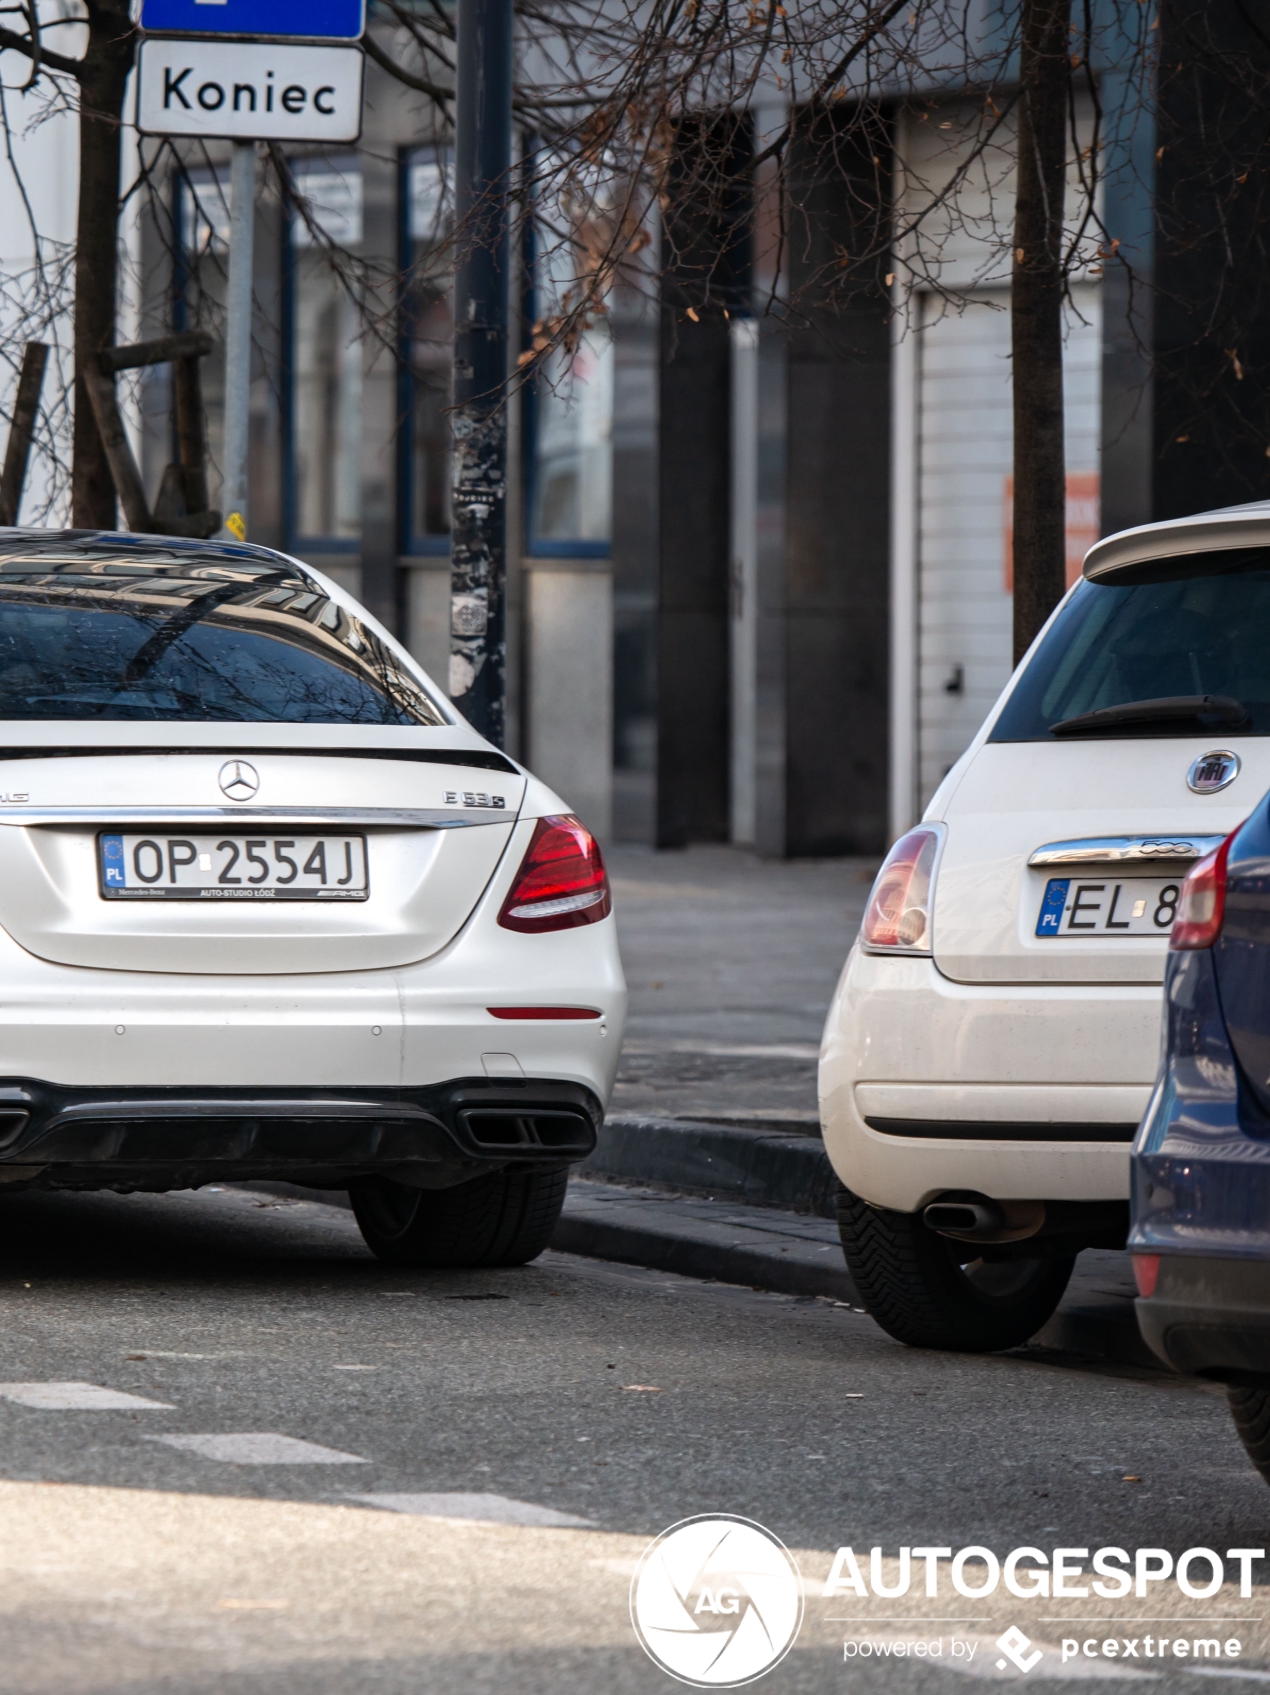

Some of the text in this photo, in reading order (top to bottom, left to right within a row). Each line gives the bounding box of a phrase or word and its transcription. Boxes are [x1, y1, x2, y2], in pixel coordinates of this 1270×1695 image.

[163, 67, 336, 115] Koniec
[1197, 762, 1229, 781] FIAT
[1139, 840, 1193, 854] 500
[133, 840, 352, 885] OP 2554J
[106, 868, 123, 881] PL
[118, 888, 166, 896] Mercedes-Benz
[200, 888, 276, 897] AUTO-STUDIO ŁÓDŹ
[1067, 884, 1130, 929] EL
[1042, 914, 1058, 926] PL
